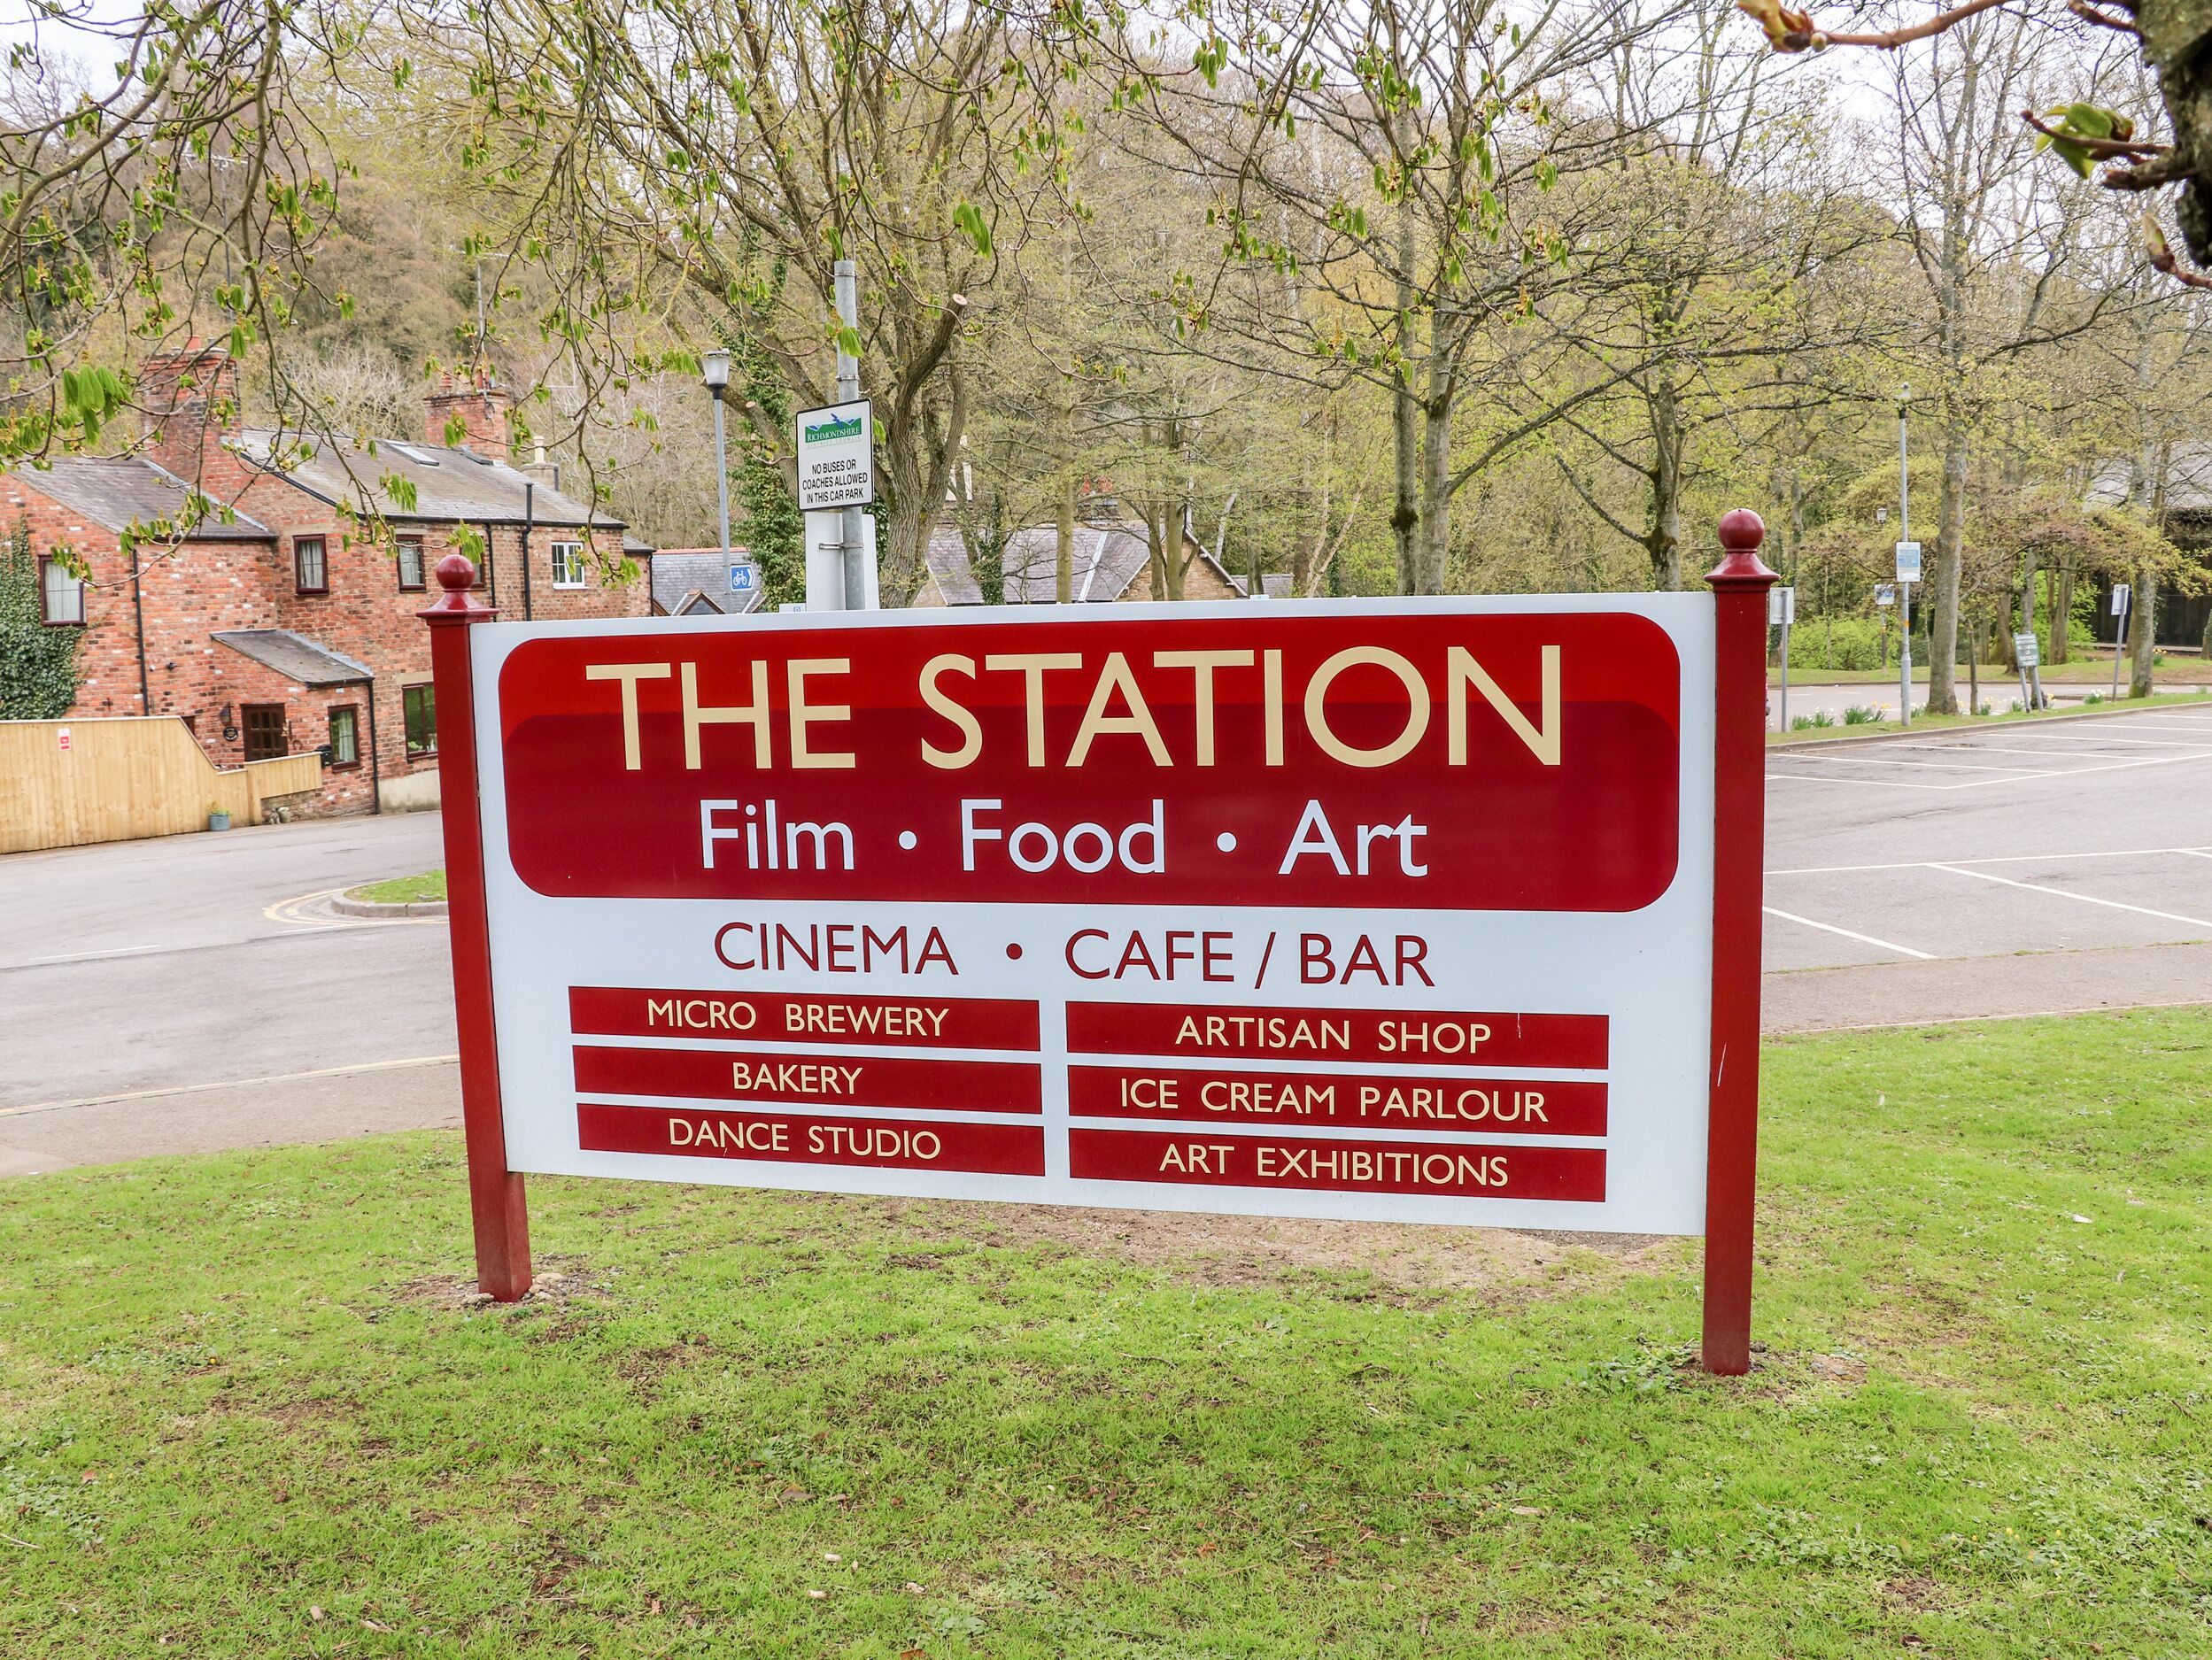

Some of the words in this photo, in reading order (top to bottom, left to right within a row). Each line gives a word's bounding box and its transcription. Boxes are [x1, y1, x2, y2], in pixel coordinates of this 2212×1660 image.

[807, 426, 860, 442] RICHMONDSHIRE
[802, 476, 833, 490] COACHES
[834, 472, 868, 486] ALLOWED
[812, 464, 822, 475] NO
[823, 460, 845, 474] BUSES
[846, 459, 856, 470] OR
[807, 492, 814, 504] IN
[815, 490, 829, 503] THIS
[830, 489, 845, 502] CAR
[845, 487, 864, 499] PARK
[585, 657, 856, 771] THE
[918, 645, 1562, 770] STATION
[700, 799, 855, 870] Film
[961, 799, 1165, 873] Food
[1278, 799, 1428, 876] Art
[714, 922, 959, 976] CINEMA
[1064, 928, 1234, 982] CAFE
[1299, 932, 1435, 987] BAR
[647, 998, 757, 1031] MICRO
[785, 1003, 949, 1037] BREWERY
[1175, 1015, 1350, 1050] ARTISAN
[1378, 1021, 1491, 1054] SHOP
[732, 1062, 863, 1095] BAKERY
[1120, 1078, 1179, 1108] ICE
[1200, 1082, 1335, 1116] CREAM
[1360, 1086, 1549, 1123] PARLOUR
[669, 1117, 790, 1152] DANCE
[808, 1125, 942, 1161] STUDIO
[1159, 1142, 1234, 1176] ART
[1257, 1147, 1509, 1187] EXHIBITIONS
